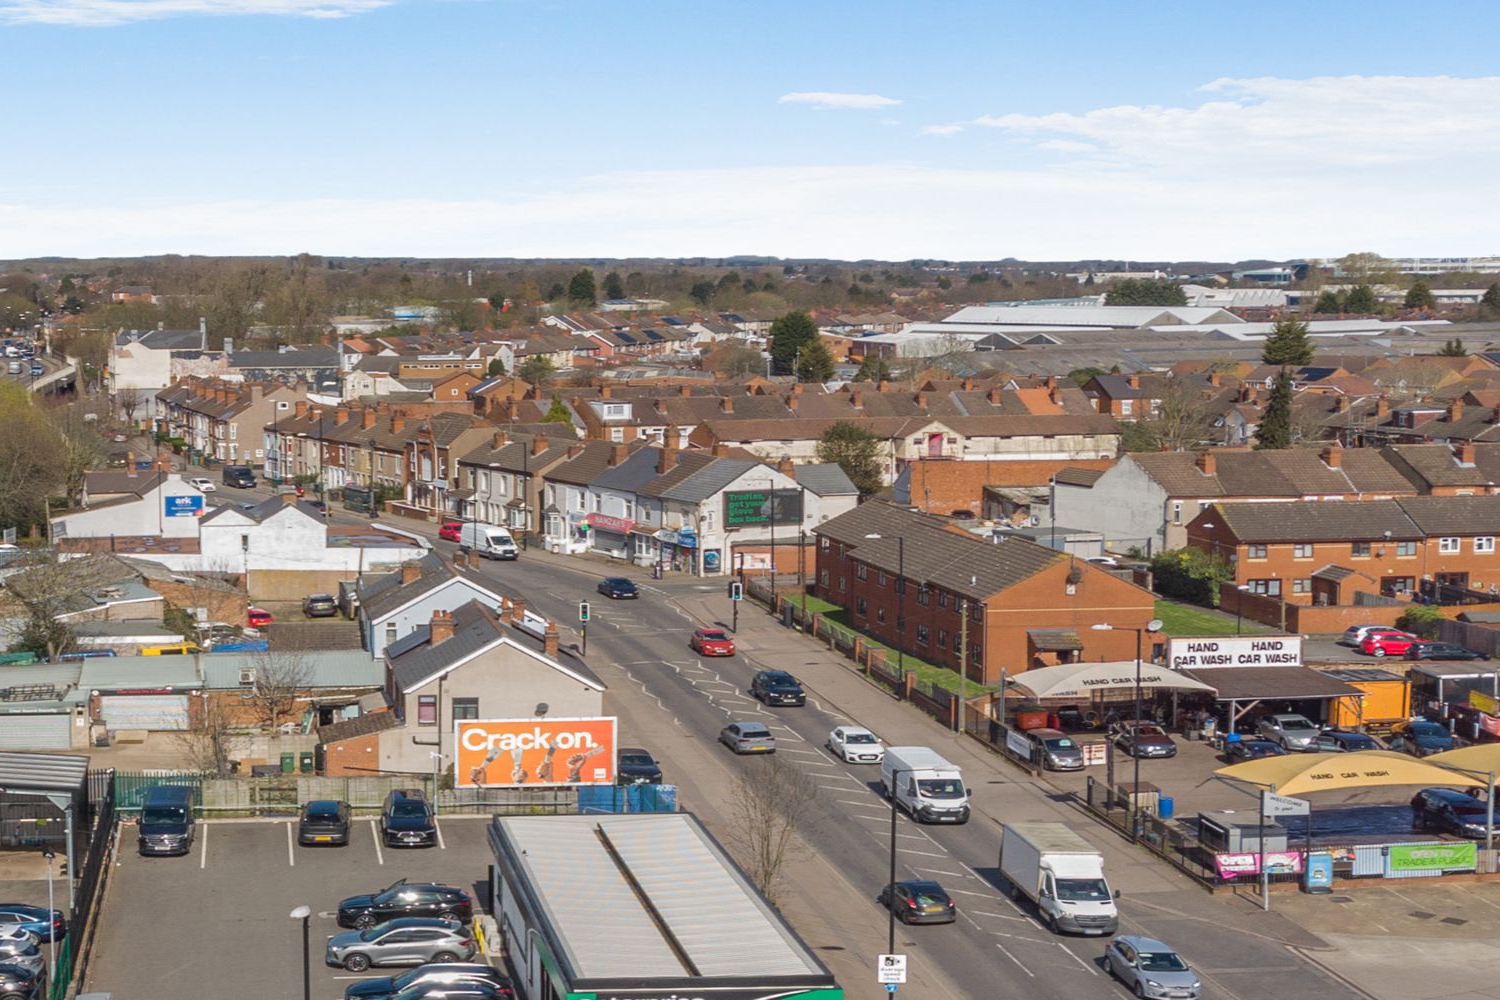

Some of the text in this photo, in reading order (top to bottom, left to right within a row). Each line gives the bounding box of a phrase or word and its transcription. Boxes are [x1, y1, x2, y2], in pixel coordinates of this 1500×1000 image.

[1187, 643, 1219, 653] HAND
[1251, 641, 1284, 651] HAND
[1174, 654, 1233, 666] CAR WASH
[1238, 653, 1298, 664] CAR WASH
[461, 727, 598, 751] Crack on.
[1364, 770, 1390, 778] WASH
[1397, 858, 1428, 867] TRADE
